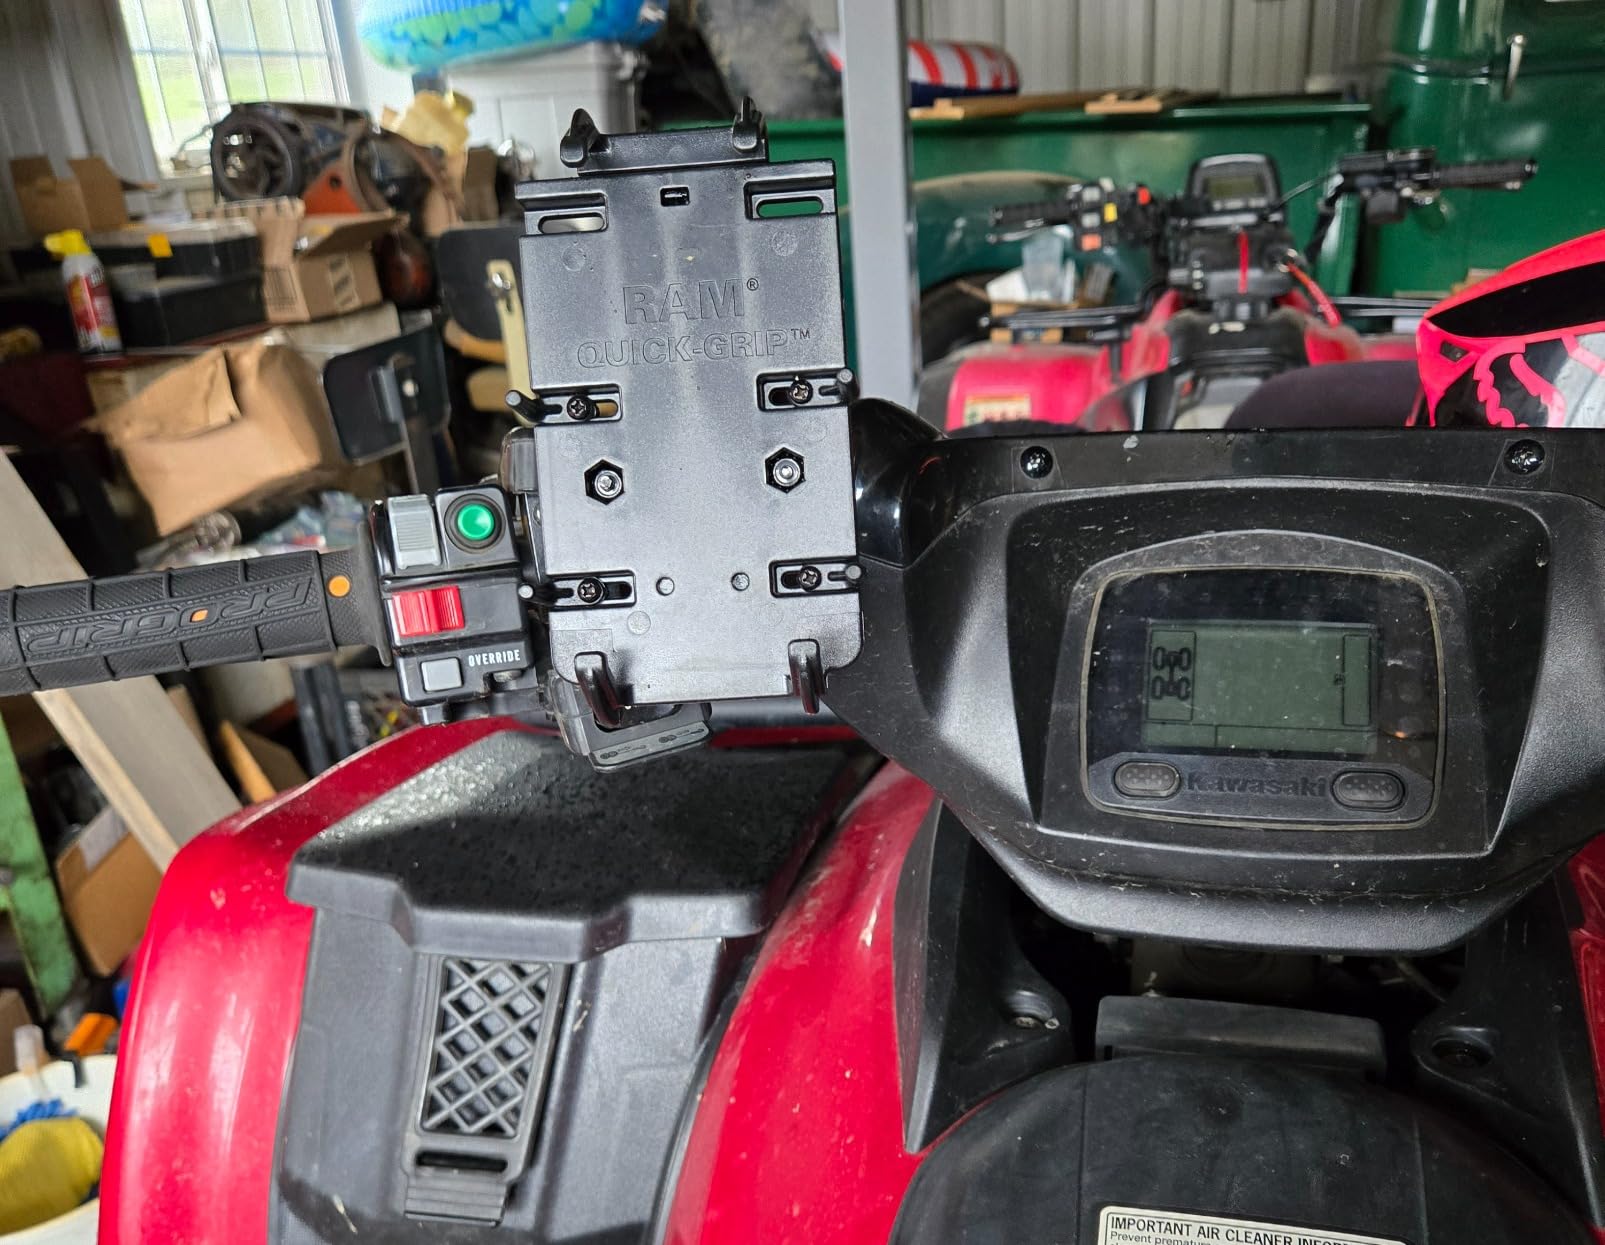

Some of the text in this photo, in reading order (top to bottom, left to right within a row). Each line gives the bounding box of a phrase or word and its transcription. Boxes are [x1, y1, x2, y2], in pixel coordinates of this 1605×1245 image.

[468, 649, 521, 667] OVERRIDE
[1187, 770, 1328, 798] Kawasaki
[1110, 1216, 1193, 1237] IMPORTANT
[1196, 1225, 1221, 1241] AIR
[1225, 1229, 1293, 1245] CLEANER
[1110, 1231, 1152, 1244] Prevent
